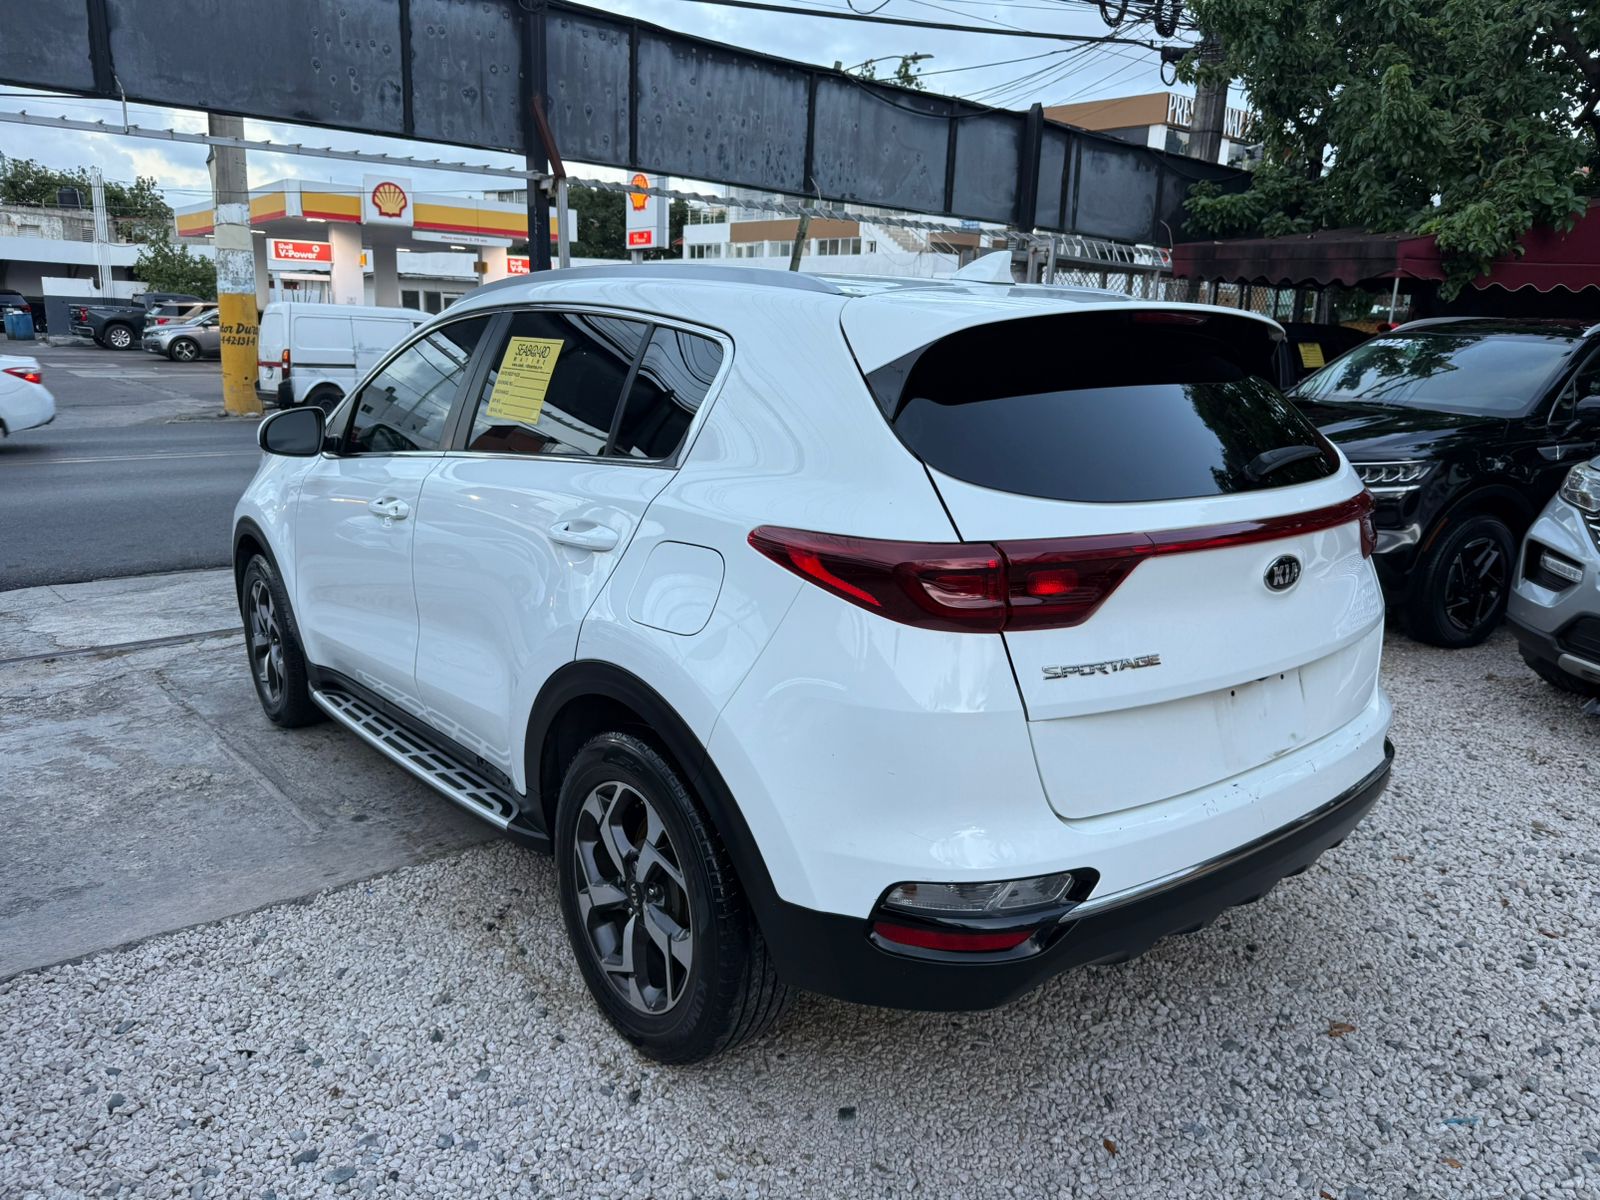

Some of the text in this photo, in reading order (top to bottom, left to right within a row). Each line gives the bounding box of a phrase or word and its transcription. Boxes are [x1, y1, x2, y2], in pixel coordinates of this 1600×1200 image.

[279, 249, 317, 259] V-Power
[1273, 562, 1298, 586] KIA
[1041, 654, 1161, 680] SPORTAGE
